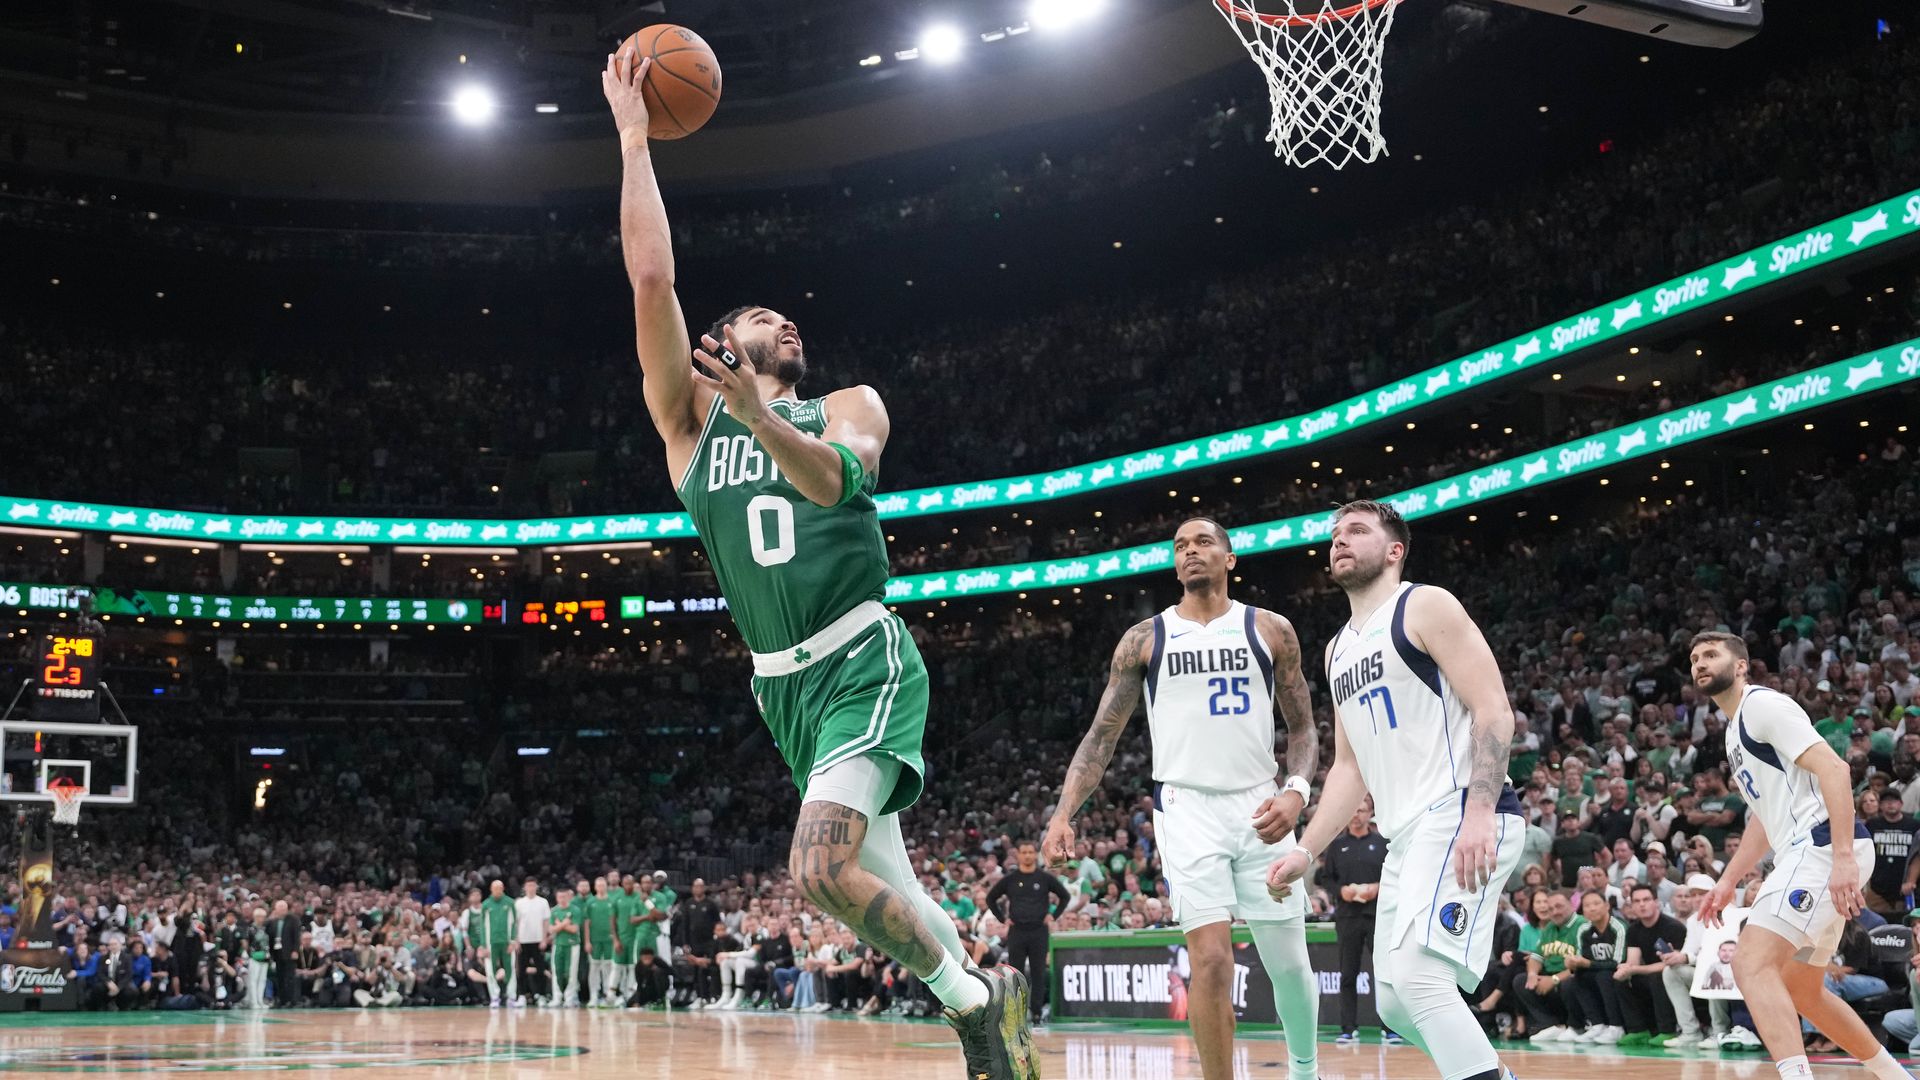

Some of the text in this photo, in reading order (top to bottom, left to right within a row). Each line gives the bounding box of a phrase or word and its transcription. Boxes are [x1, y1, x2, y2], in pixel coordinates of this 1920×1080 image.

[721, 350, 736, 366] 0
[871, 495, 909, 514] prite
[950, 484, 998, 507] Sprite
[1041, 471, 1083, 496] Sprite
[1121, 453, 1165, 479] Sprite
[1206, 433, 1253, 460] Sprite
[1297, 411, 1339, 440] Sprite
[1375, 383, 1417, 414] Sprite
[1457, 351, 1504, 384] Sprite
[1549, 316, 1601, 352] Sprite
[1652, 277, 1710, 315] Sprite
[1768, 232, 1834, 273] Sprite
[790, 408, 816, 417] VISTA
[791, 414, 817, 423] PRINT
[1466, 468, 1513, 499] Sprite
[1556, 440, 1606, 474] Sprite
[1656, 410, 1712, 445] Sprite
[1768, 375, 1831, 413] Sprite
[47, 504, 649, 542] Sprite Sprite Sprite Sprite Sprite Sprite Sprite
[747, 495, 796, 568] 0
[954, 571, 1001, 593] Sprite
[1043, 561, 1090, 585] Sprite
[1127, 546, 1170, 572] Sprite
[1300, 514, 1335, 541] Spri
[336, 608, 345, 619] 7
[622, 600, 642, 614] TD
[646, 600, 675, 612] Bank
[681, 598, 715, 611] 10:52
[53, 637, 93, 657] 2:48
[45, 653, 81, 685] 2.3
[1168, 648, 1248, 677] DALLAS
[1334, 650, 1384, 706] DALLAS
[54, 688, 95, 699] TISSOT
[1208, 677, 1250, 715] 25
[1359, 686, 1398, 735] 77
[1874, 832, 1913, 845] WHATEVER
[1885, 844, 1908, 857] TAKES
[8, 966, 67, 993] Finals
[1063, 963, 1172, 1003] GET IN THE GAME
